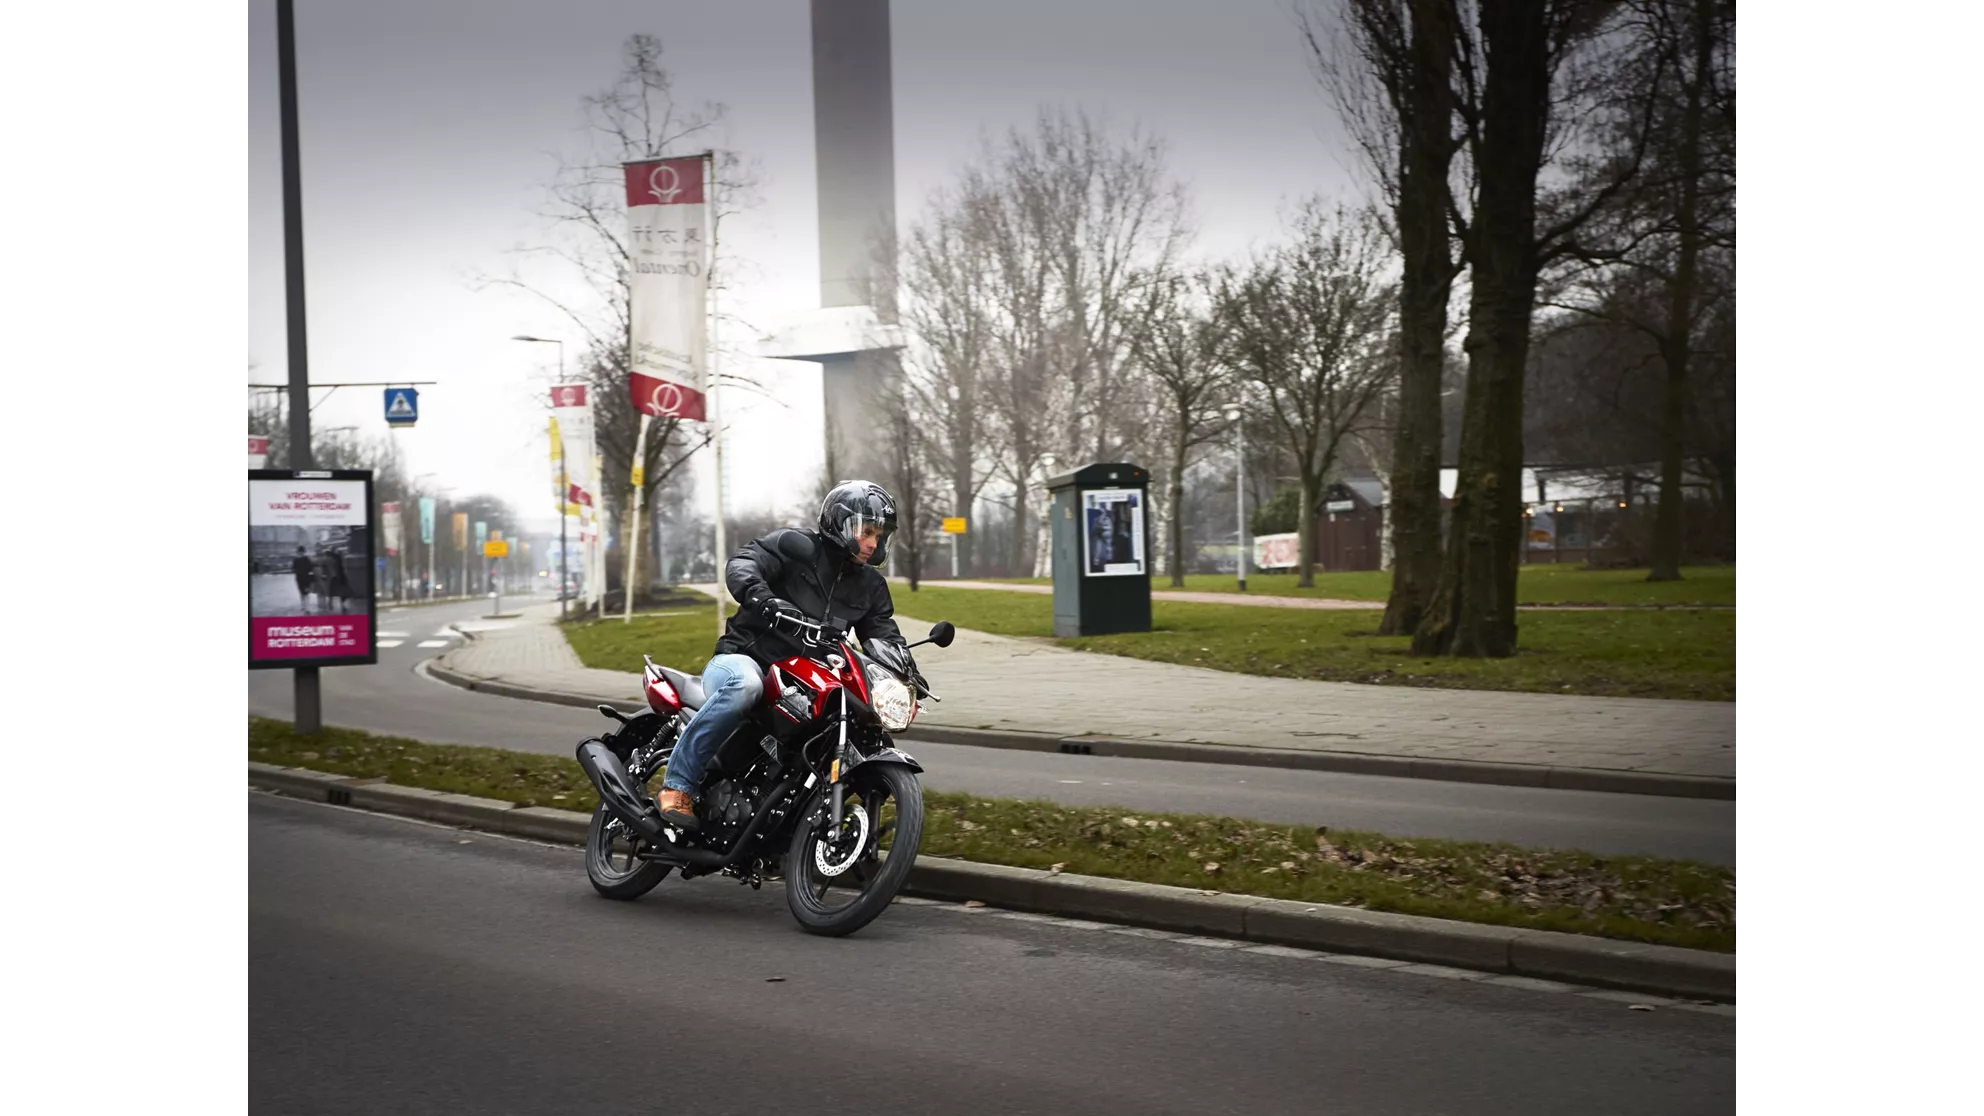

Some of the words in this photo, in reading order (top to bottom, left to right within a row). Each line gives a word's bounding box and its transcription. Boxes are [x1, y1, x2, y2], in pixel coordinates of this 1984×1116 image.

[285, 492, 337, 501] VROUWEN
[268, 502, 292, 511] VAN
[294, 502, 352, 511] ROTTERDAM
[267, 625, 335, 637] museum
[267, 638, 335, 648] ROTTERDAM
